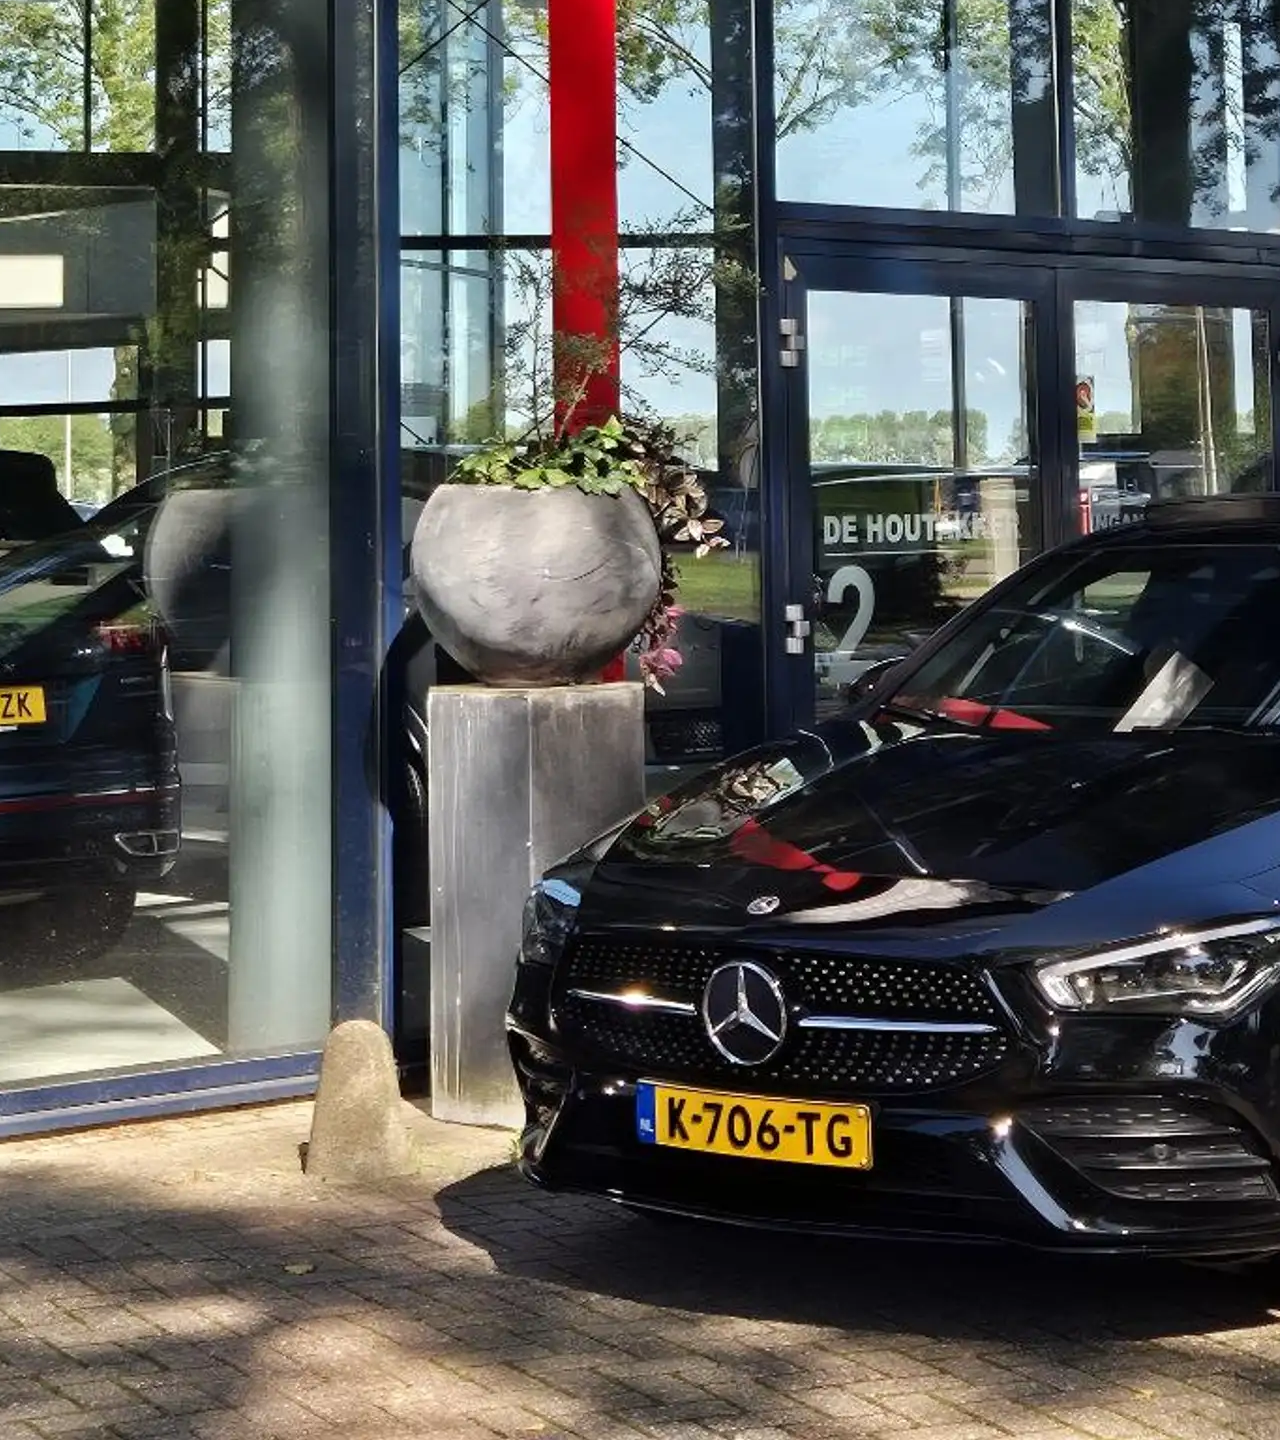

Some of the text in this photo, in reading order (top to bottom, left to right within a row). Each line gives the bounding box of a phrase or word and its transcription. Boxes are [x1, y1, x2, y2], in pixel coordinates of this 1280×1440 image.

[823, 514, 859, 545] DE
[826, 564, 876, 685] 2
[667, 1096, 854, 1159] K-706-TG
